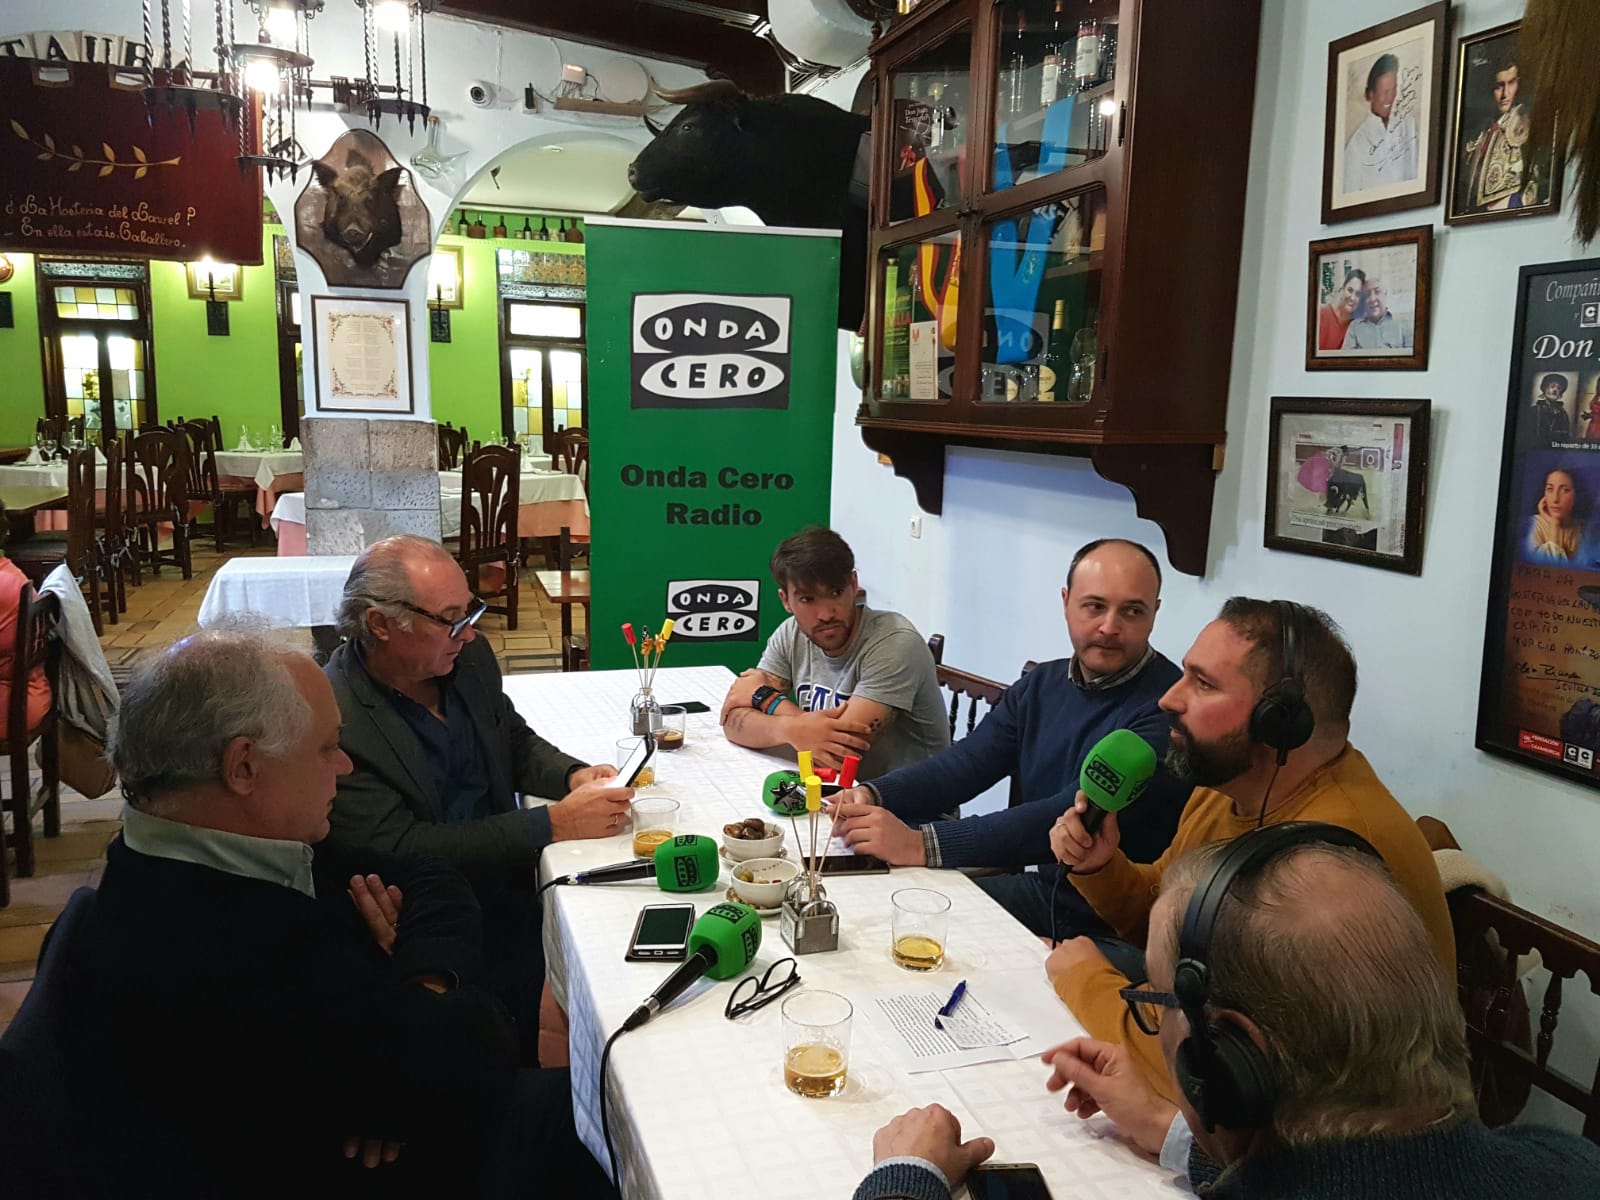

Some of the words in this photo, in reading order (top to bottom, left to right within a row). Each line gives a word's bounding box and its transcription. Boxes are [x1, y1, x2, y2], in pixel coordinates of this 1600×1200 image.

[108, 204, 128, 219] del
[654, 317, 767, 341] ONDA
[1532, 334, 1594, 359] Don
[660, 362, 766, 389] CERO
[620, 464, 707, 488] Onda
[718, 466, 794, 490] Cero
[666, 503, 762, 525] Radio
[680, 593, 745, 606] ONDA
[683, 617, 745, 632] CERO
